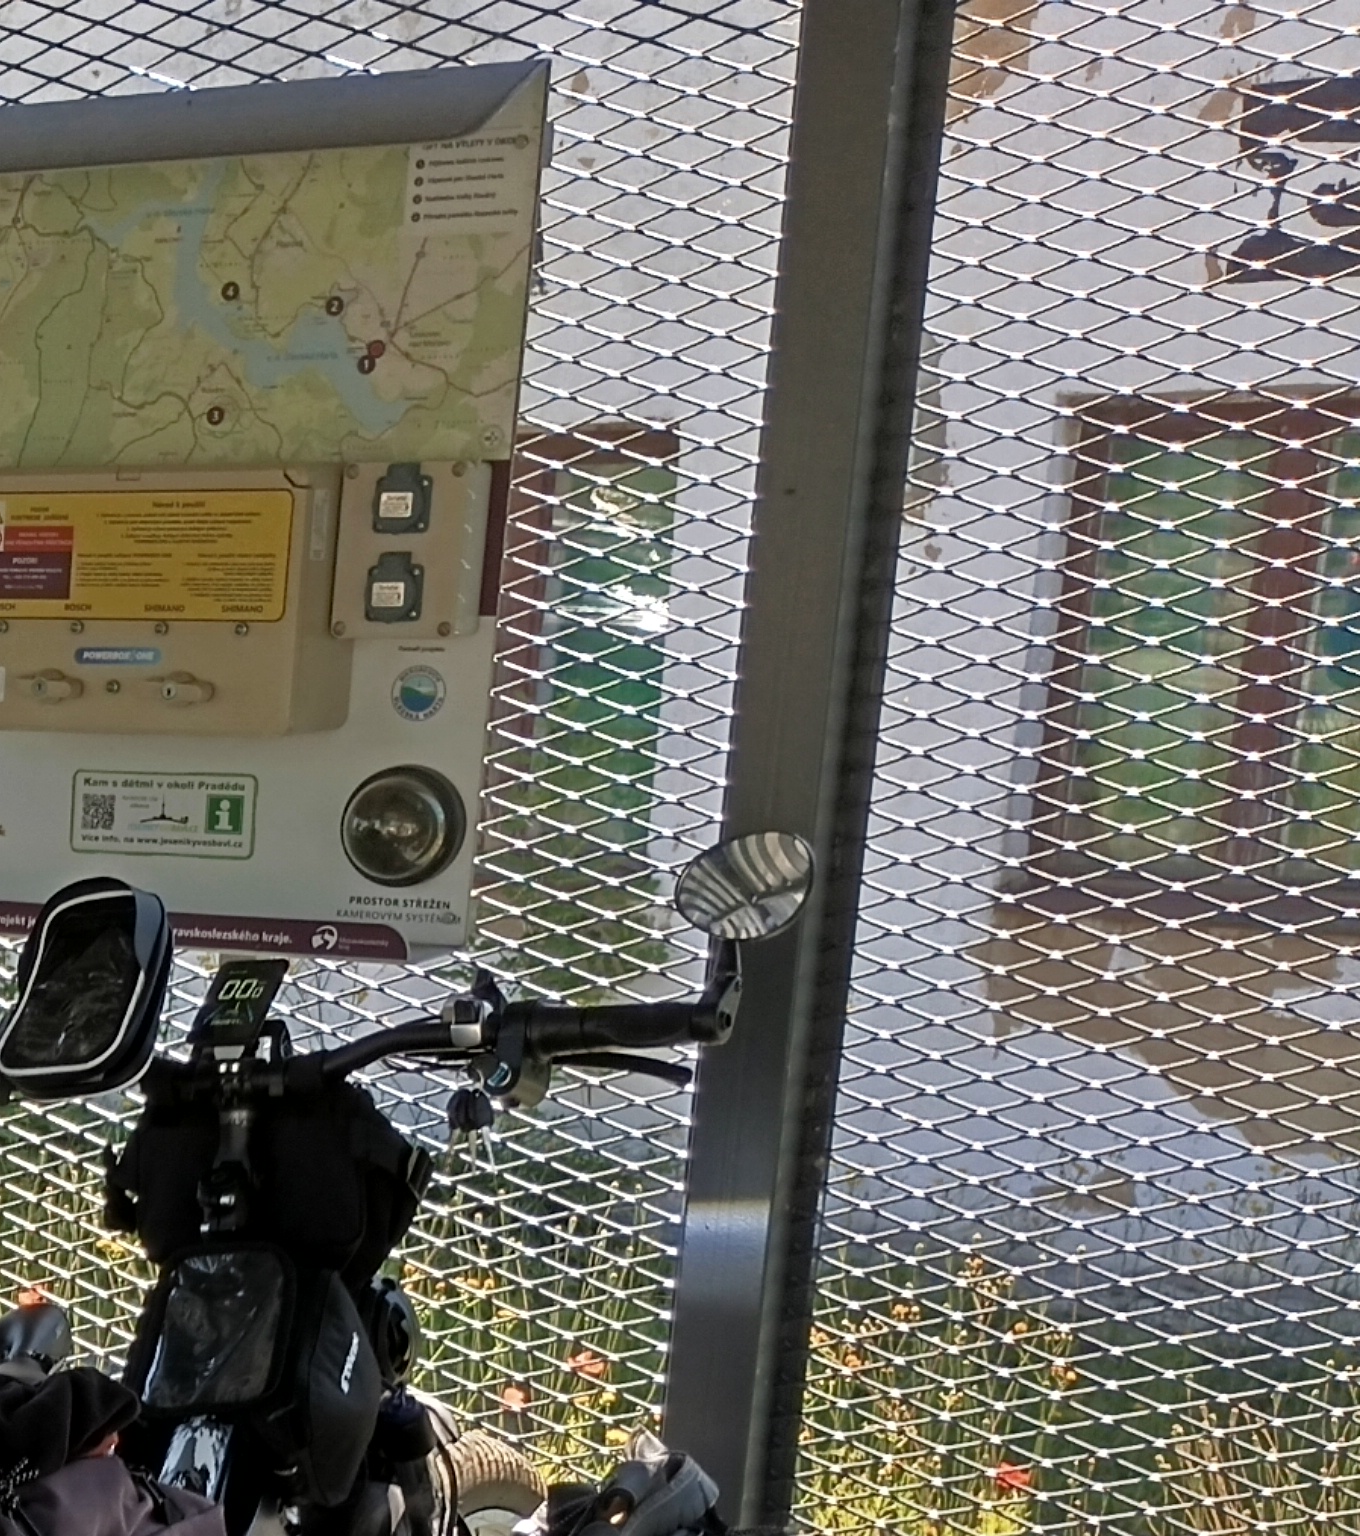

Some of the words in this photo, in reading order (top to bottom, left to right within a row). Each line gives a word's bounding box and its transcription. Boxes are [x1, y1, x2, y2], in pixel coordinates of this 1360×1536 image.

[349, 896, 399, 907] PROSTOR
[403, 897, 451, 910] STŘEŽEN
[336, 909, 403, 920] KAMEROVÝM
[173, 927, 260, 942] ravskoslezského
